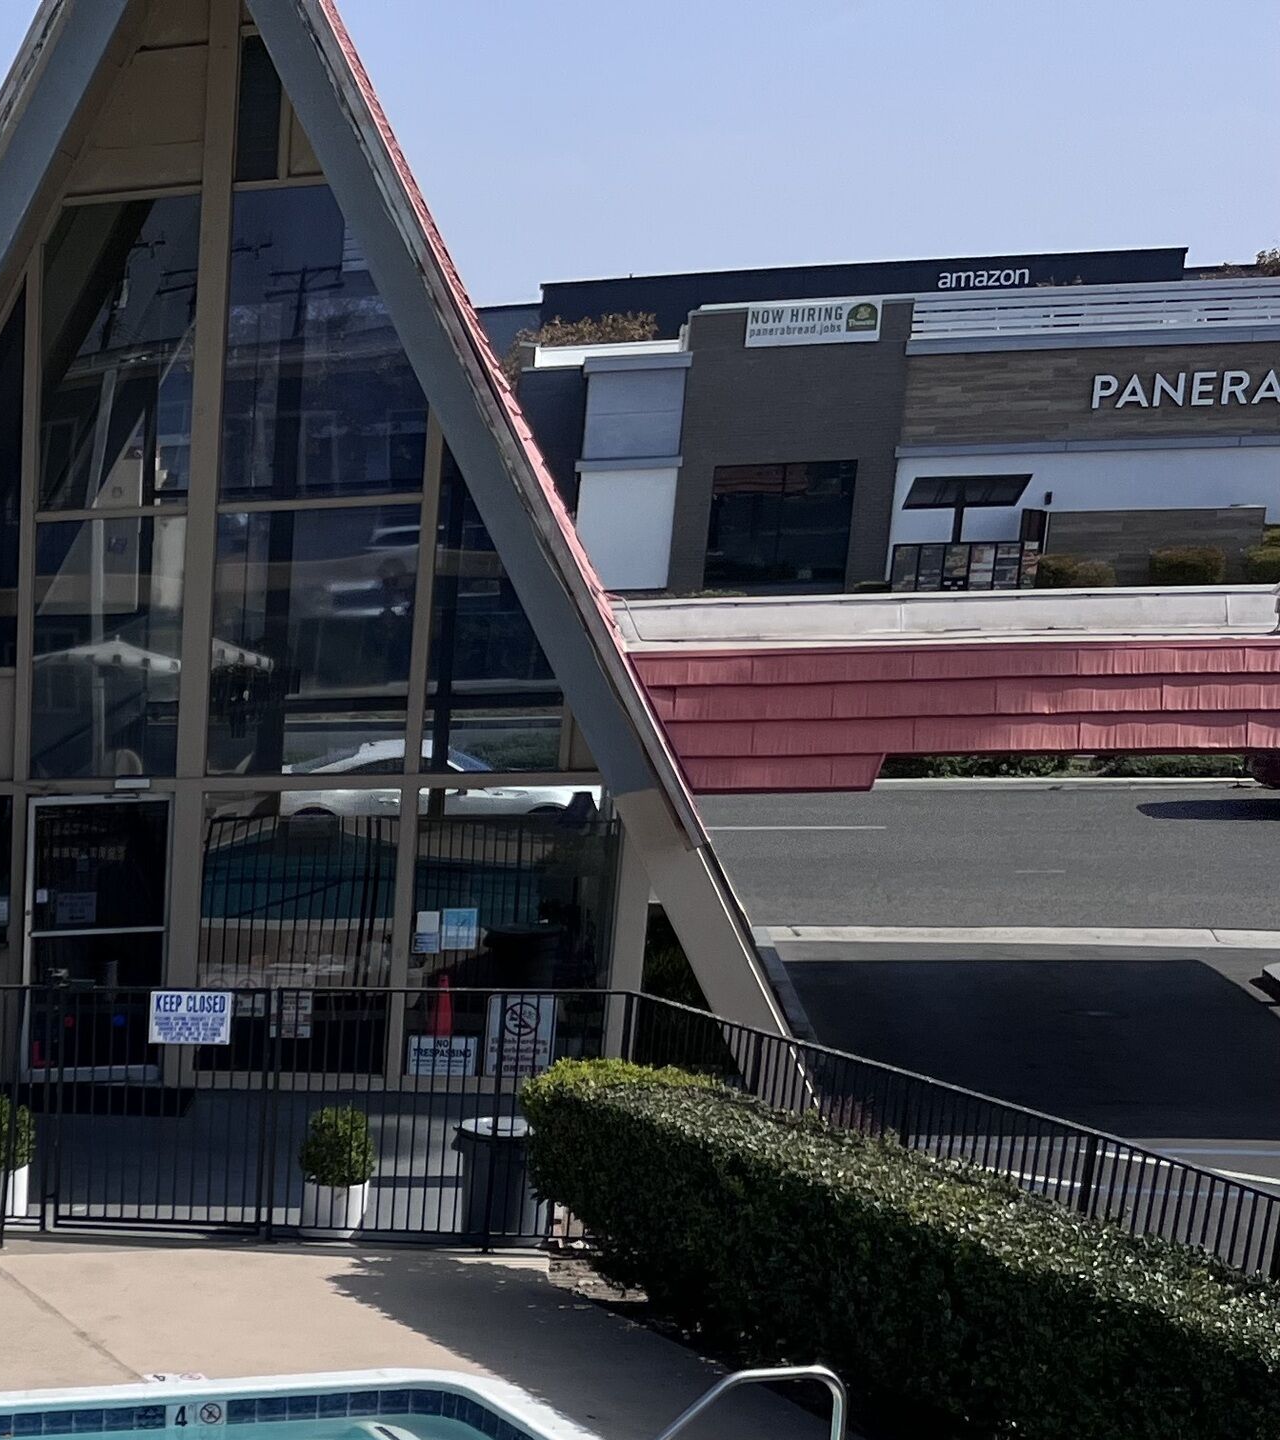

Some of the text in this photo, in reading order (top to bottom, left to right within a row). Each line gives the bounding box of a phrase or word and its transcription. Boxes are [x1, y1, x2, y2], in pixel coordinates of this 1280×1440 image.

[937, 267, 1030, 289] amazon
[750, 306, 843, 325] NOW HIRING
[749, 323, 842, 339] panerabread.jobs
[1091, 369, 1280, 409] PANERA
[155, 994, 226, 1013] KEEP CLOSED
[436, 1039, 449, 1048] NO
[174, 1405, 188, 1427] 4
